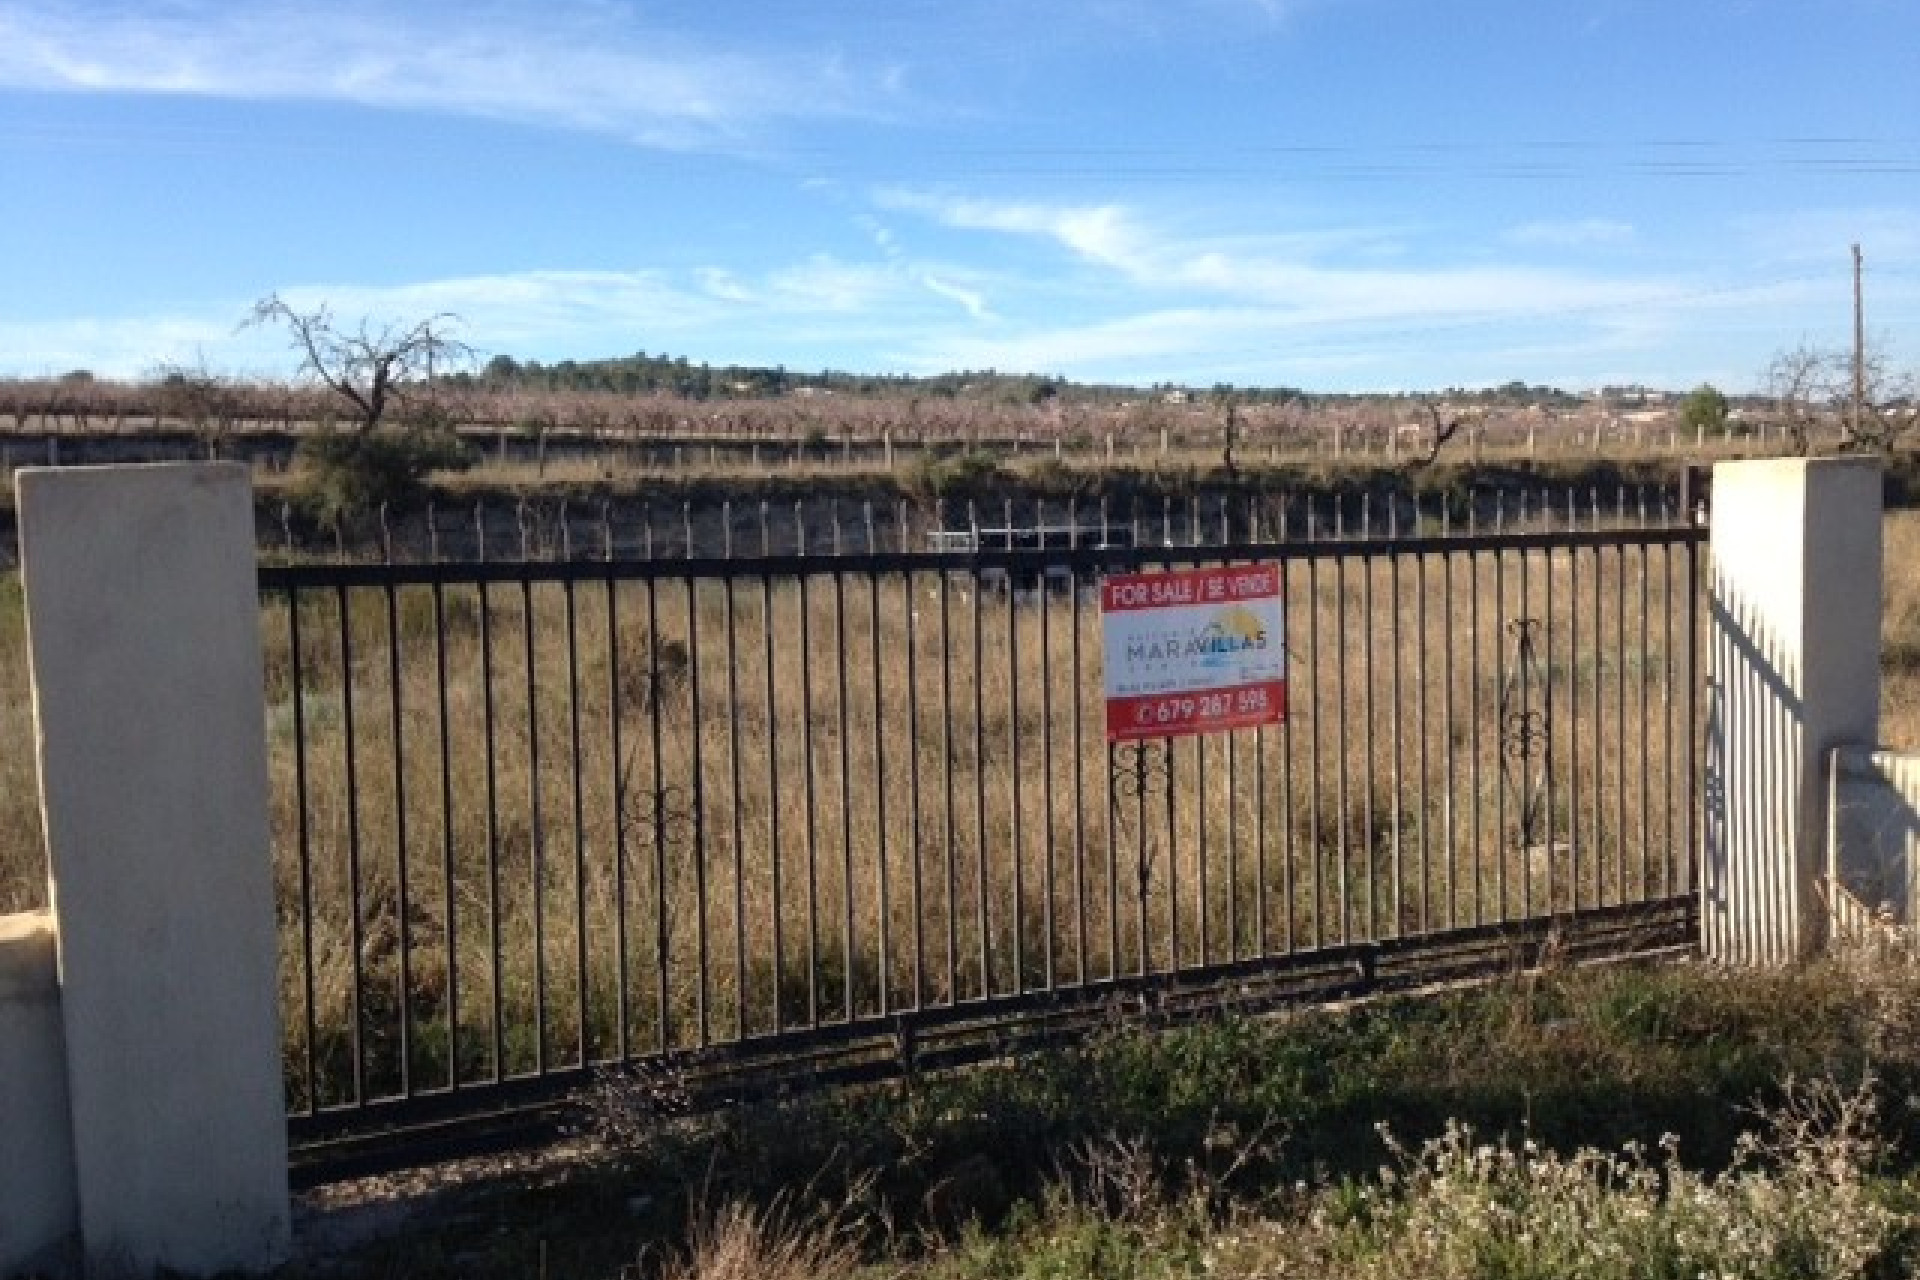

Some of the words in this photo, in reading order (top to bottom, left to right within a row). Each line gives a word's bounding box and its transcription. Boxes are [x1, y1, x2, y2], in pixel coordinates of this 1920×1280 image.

[1112, 583, 1148, 605] FOR
[1151, 579, 1191, 603] SALE
[1127, 630, 1267, 662] MARAVILLAS
[1157, 697, 1195, 722] 679
[1199, 693, 1233, 716] 287
